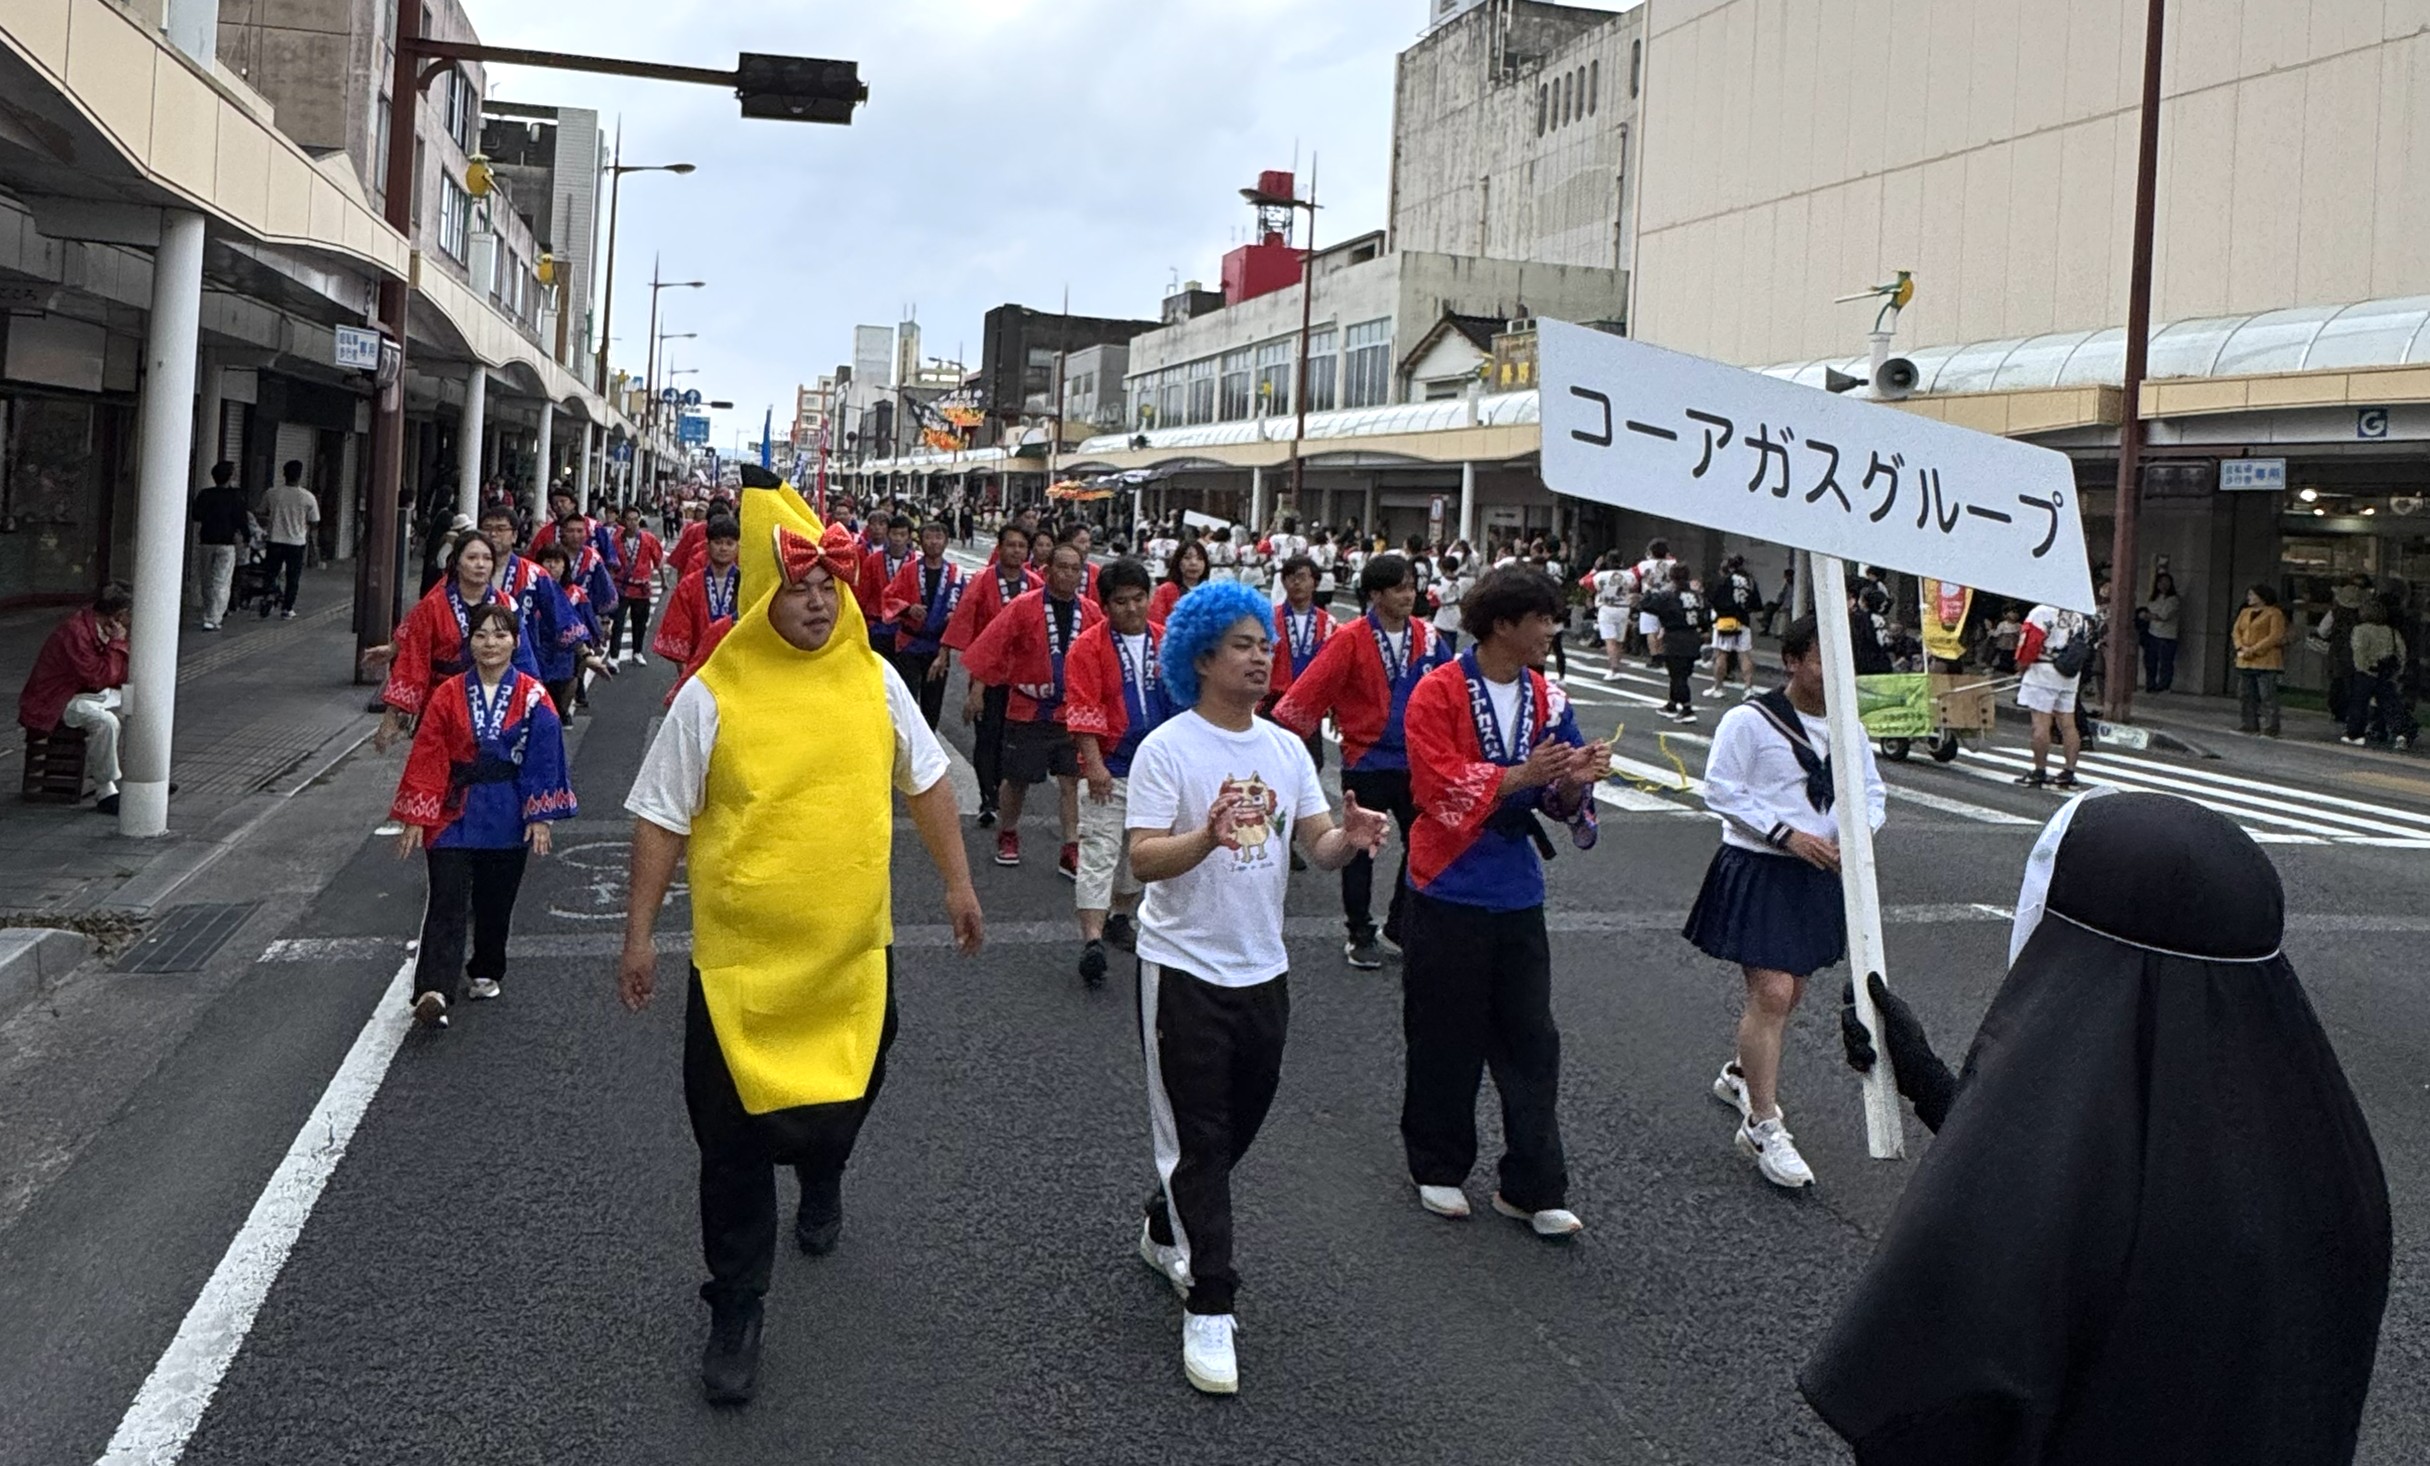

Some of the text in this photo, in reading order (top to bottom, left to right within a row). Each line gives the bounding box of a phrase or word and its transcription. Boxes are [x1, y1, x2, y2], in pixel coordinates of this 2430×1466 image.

[1570, 385, 2064, 558] コーアガスグループ
[2360, 411, 2386, 436] G
